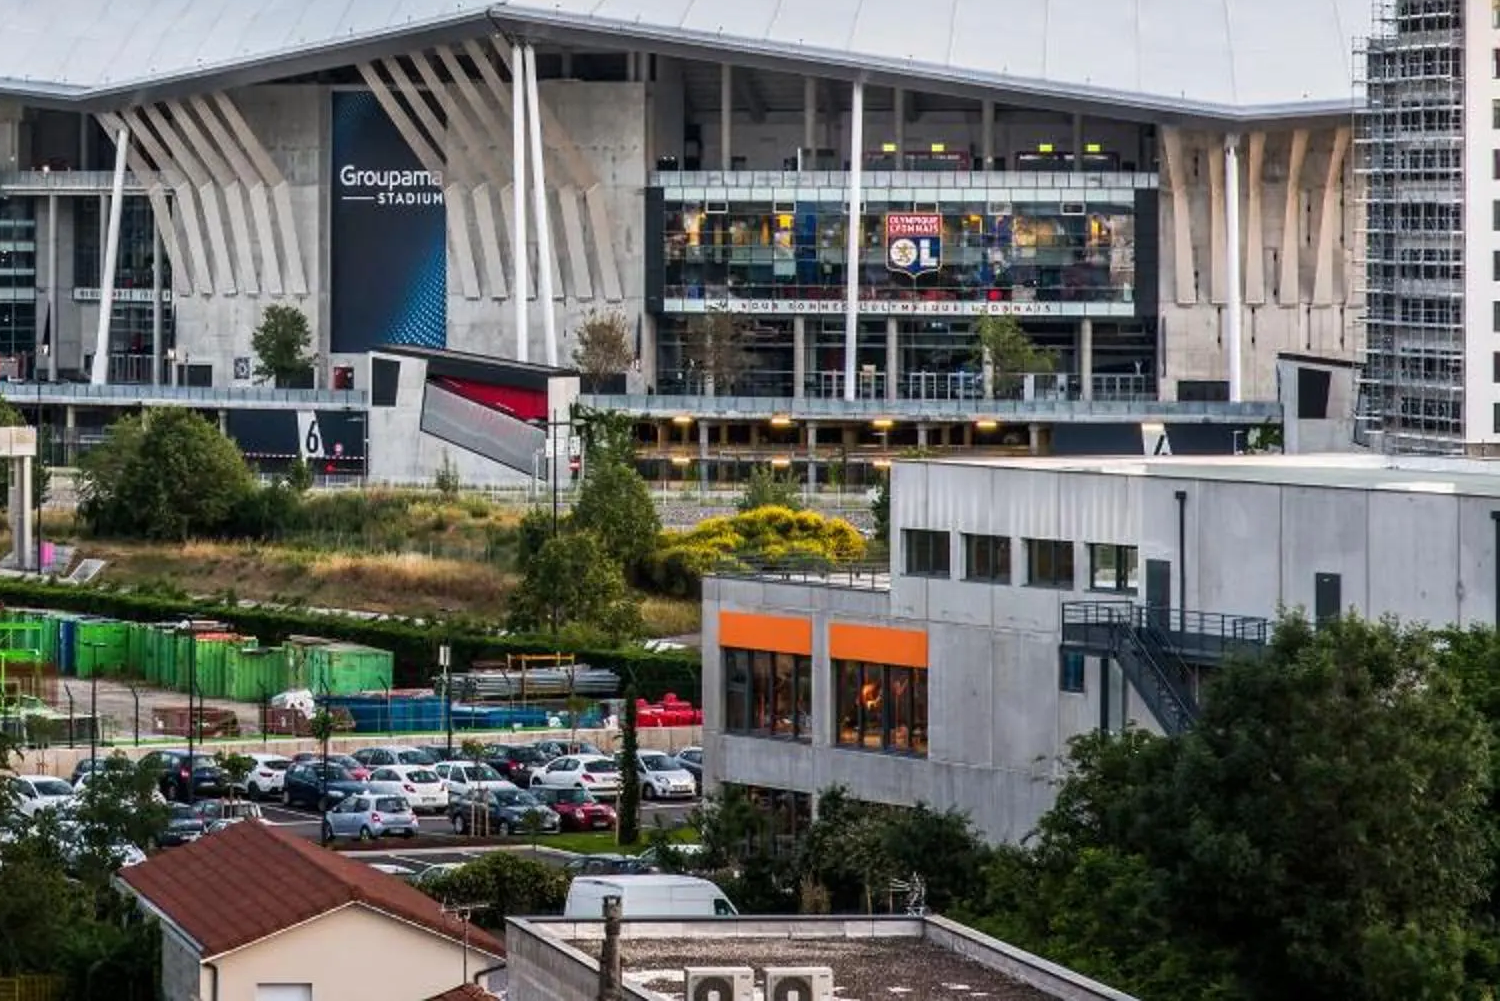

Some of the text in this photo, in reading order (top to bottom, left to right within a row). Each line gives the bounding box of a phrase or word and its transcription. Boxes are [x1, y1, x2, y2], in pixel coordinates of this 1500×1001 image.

[340, 165, 443, 191] Groupama
[377, 192, 443, 205] STADIUM
[890, 238, 938, 267] OL
[306, 420, 319, 453] 6
